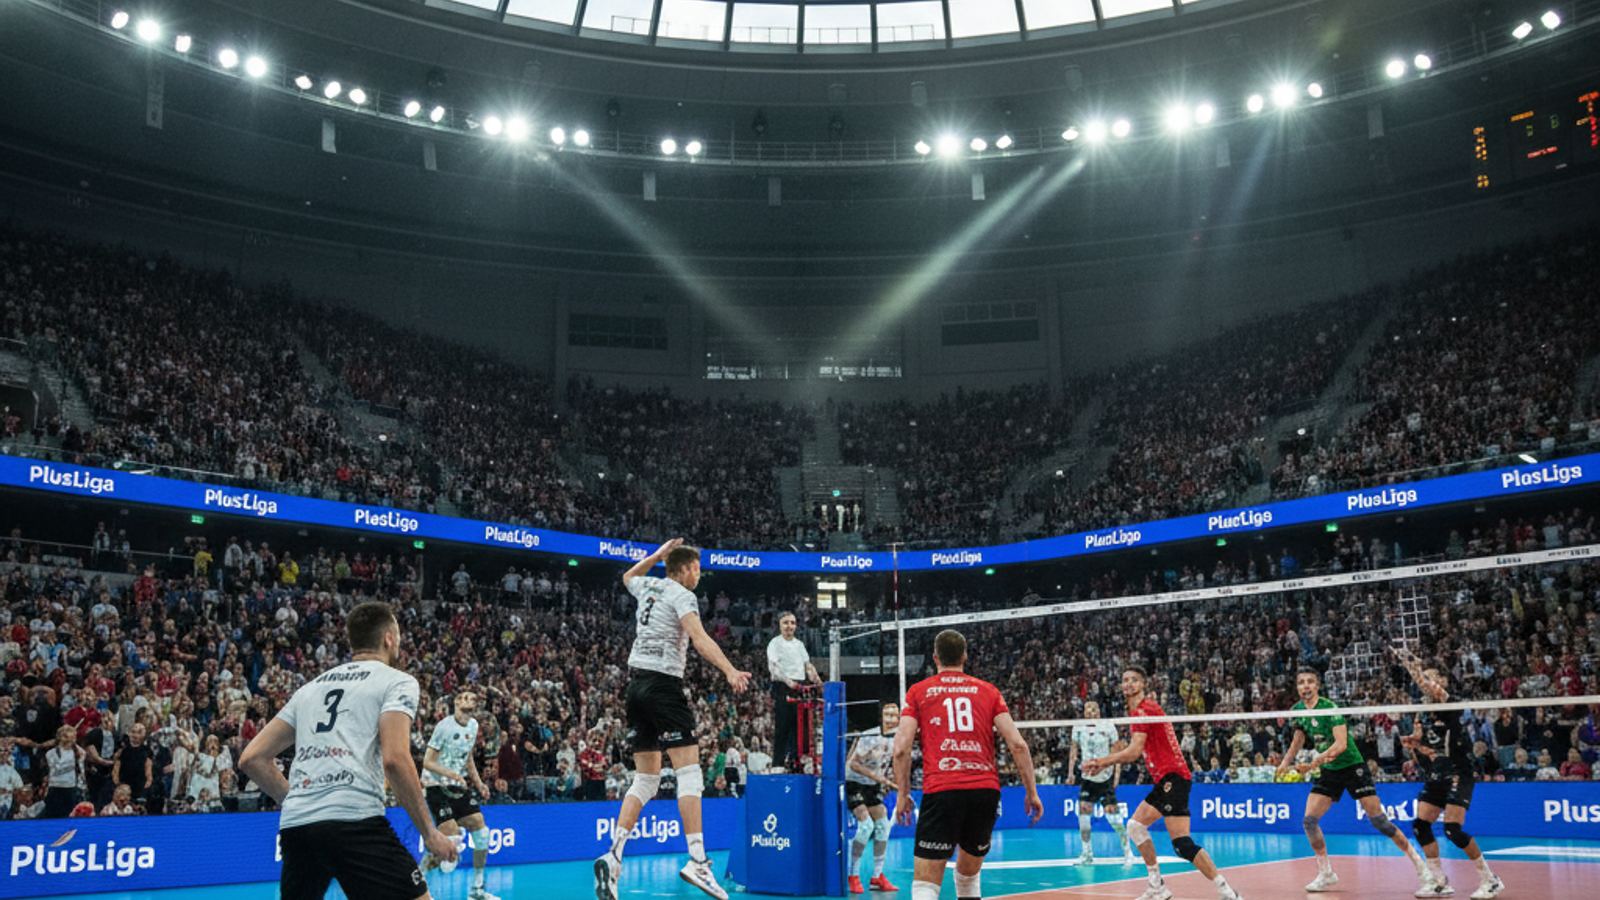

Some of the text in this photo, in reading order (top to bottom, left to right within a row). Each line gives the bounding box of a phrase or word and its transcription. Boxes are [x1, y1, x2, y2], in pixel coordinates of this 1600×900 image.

[29, 465, 115, 494] PlusLiga
[315, 688, 345, 733] 3
[942, 697, 974, 732] 18
[1201, 798, 1290, 824] PlusLiga
[596, 815, 680, 843] PlsLiga
[10, 840, 155, 877] PlusLiga
